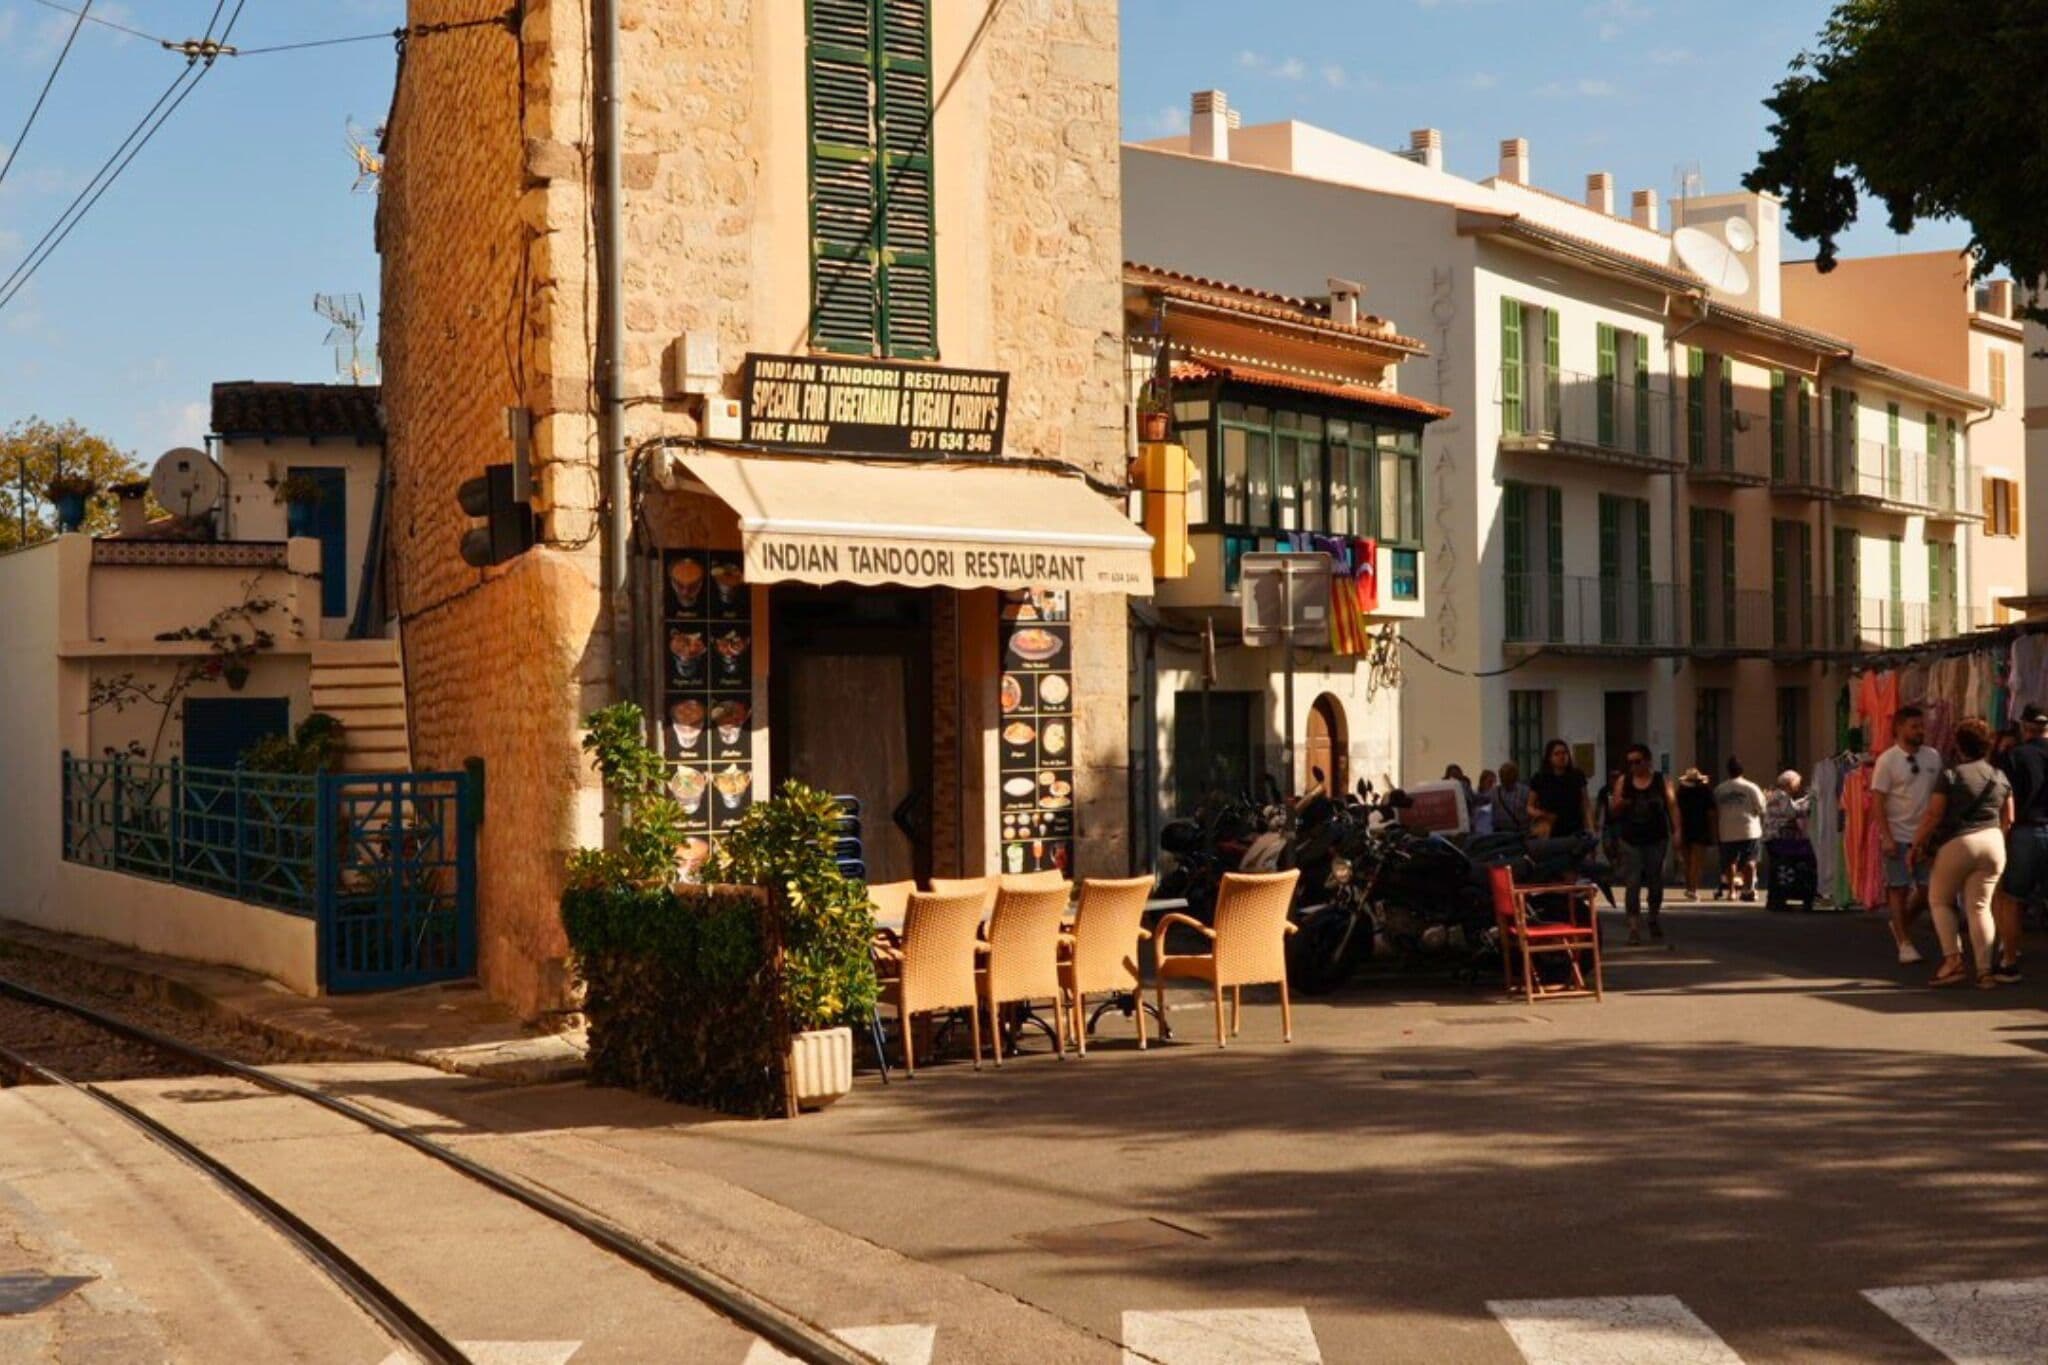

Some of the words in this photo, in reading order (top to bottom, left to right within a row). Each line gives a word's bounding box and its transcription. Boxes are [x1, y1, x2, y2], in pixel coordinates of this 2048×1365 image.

[755, 360, 816, 382] INDIAN
[821, 365, 899, 388] TANDOORI
[904, 371, 1000, 394] RESTAURANT
[751, 380, 800, 419] SPECIAL
[803, 384, 826, 421] FOR
[829, 385, 900, 425] VEGETARIAN
[901, 391, 910, 427] &
[912, 391, 950, 428] VEGAN
[952, 393, 999, 431] CURRY'S
[750, 421, 784, 441] TAKE
[786, 424, 830, 443] AWAY
[910, 430, 934, 449] 971
[939, 432, 964, 450] 634
[967, 434, 992, 452] 346
[762, 542, 838, 573] INDIAN
[848, 546, 954, 578] TANDOORI
[965, 552, 1085, 582] RESTAURANT
